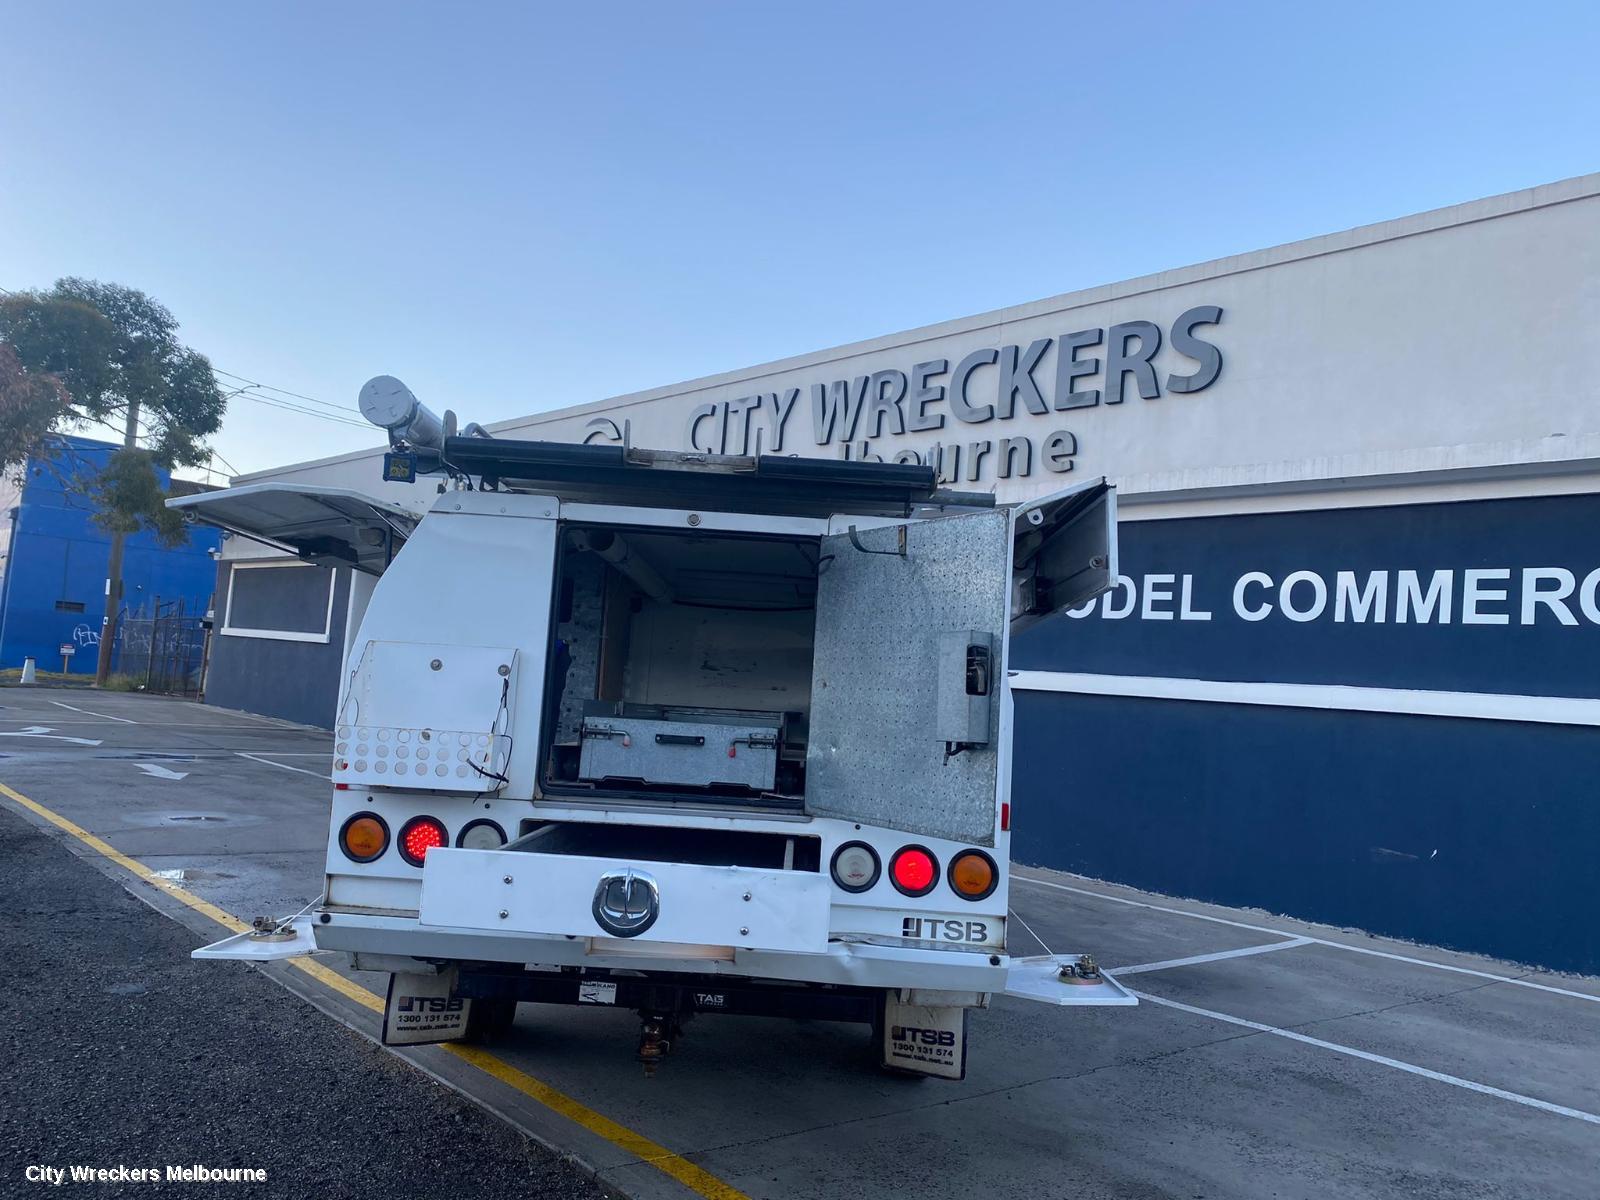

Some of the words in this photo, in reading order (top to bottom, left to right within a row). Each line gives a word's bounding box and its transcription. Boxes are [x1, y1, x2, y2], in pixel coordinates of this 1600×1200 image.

[686, 387, 800, 456] CITY
[811, 305, 1223, 445] WRECKERS
[1065, 573, 1213, 621] DEL
[924, 918, 988, 943] TSB
[414, 996, 464, 1012] TSB
[906, 1027, 955, 1047] TSB
[893, 1042, 915, 1052] 1300
[917, 1046, 933, 1056] 131
[936, 1048, 954, 1058] 574
